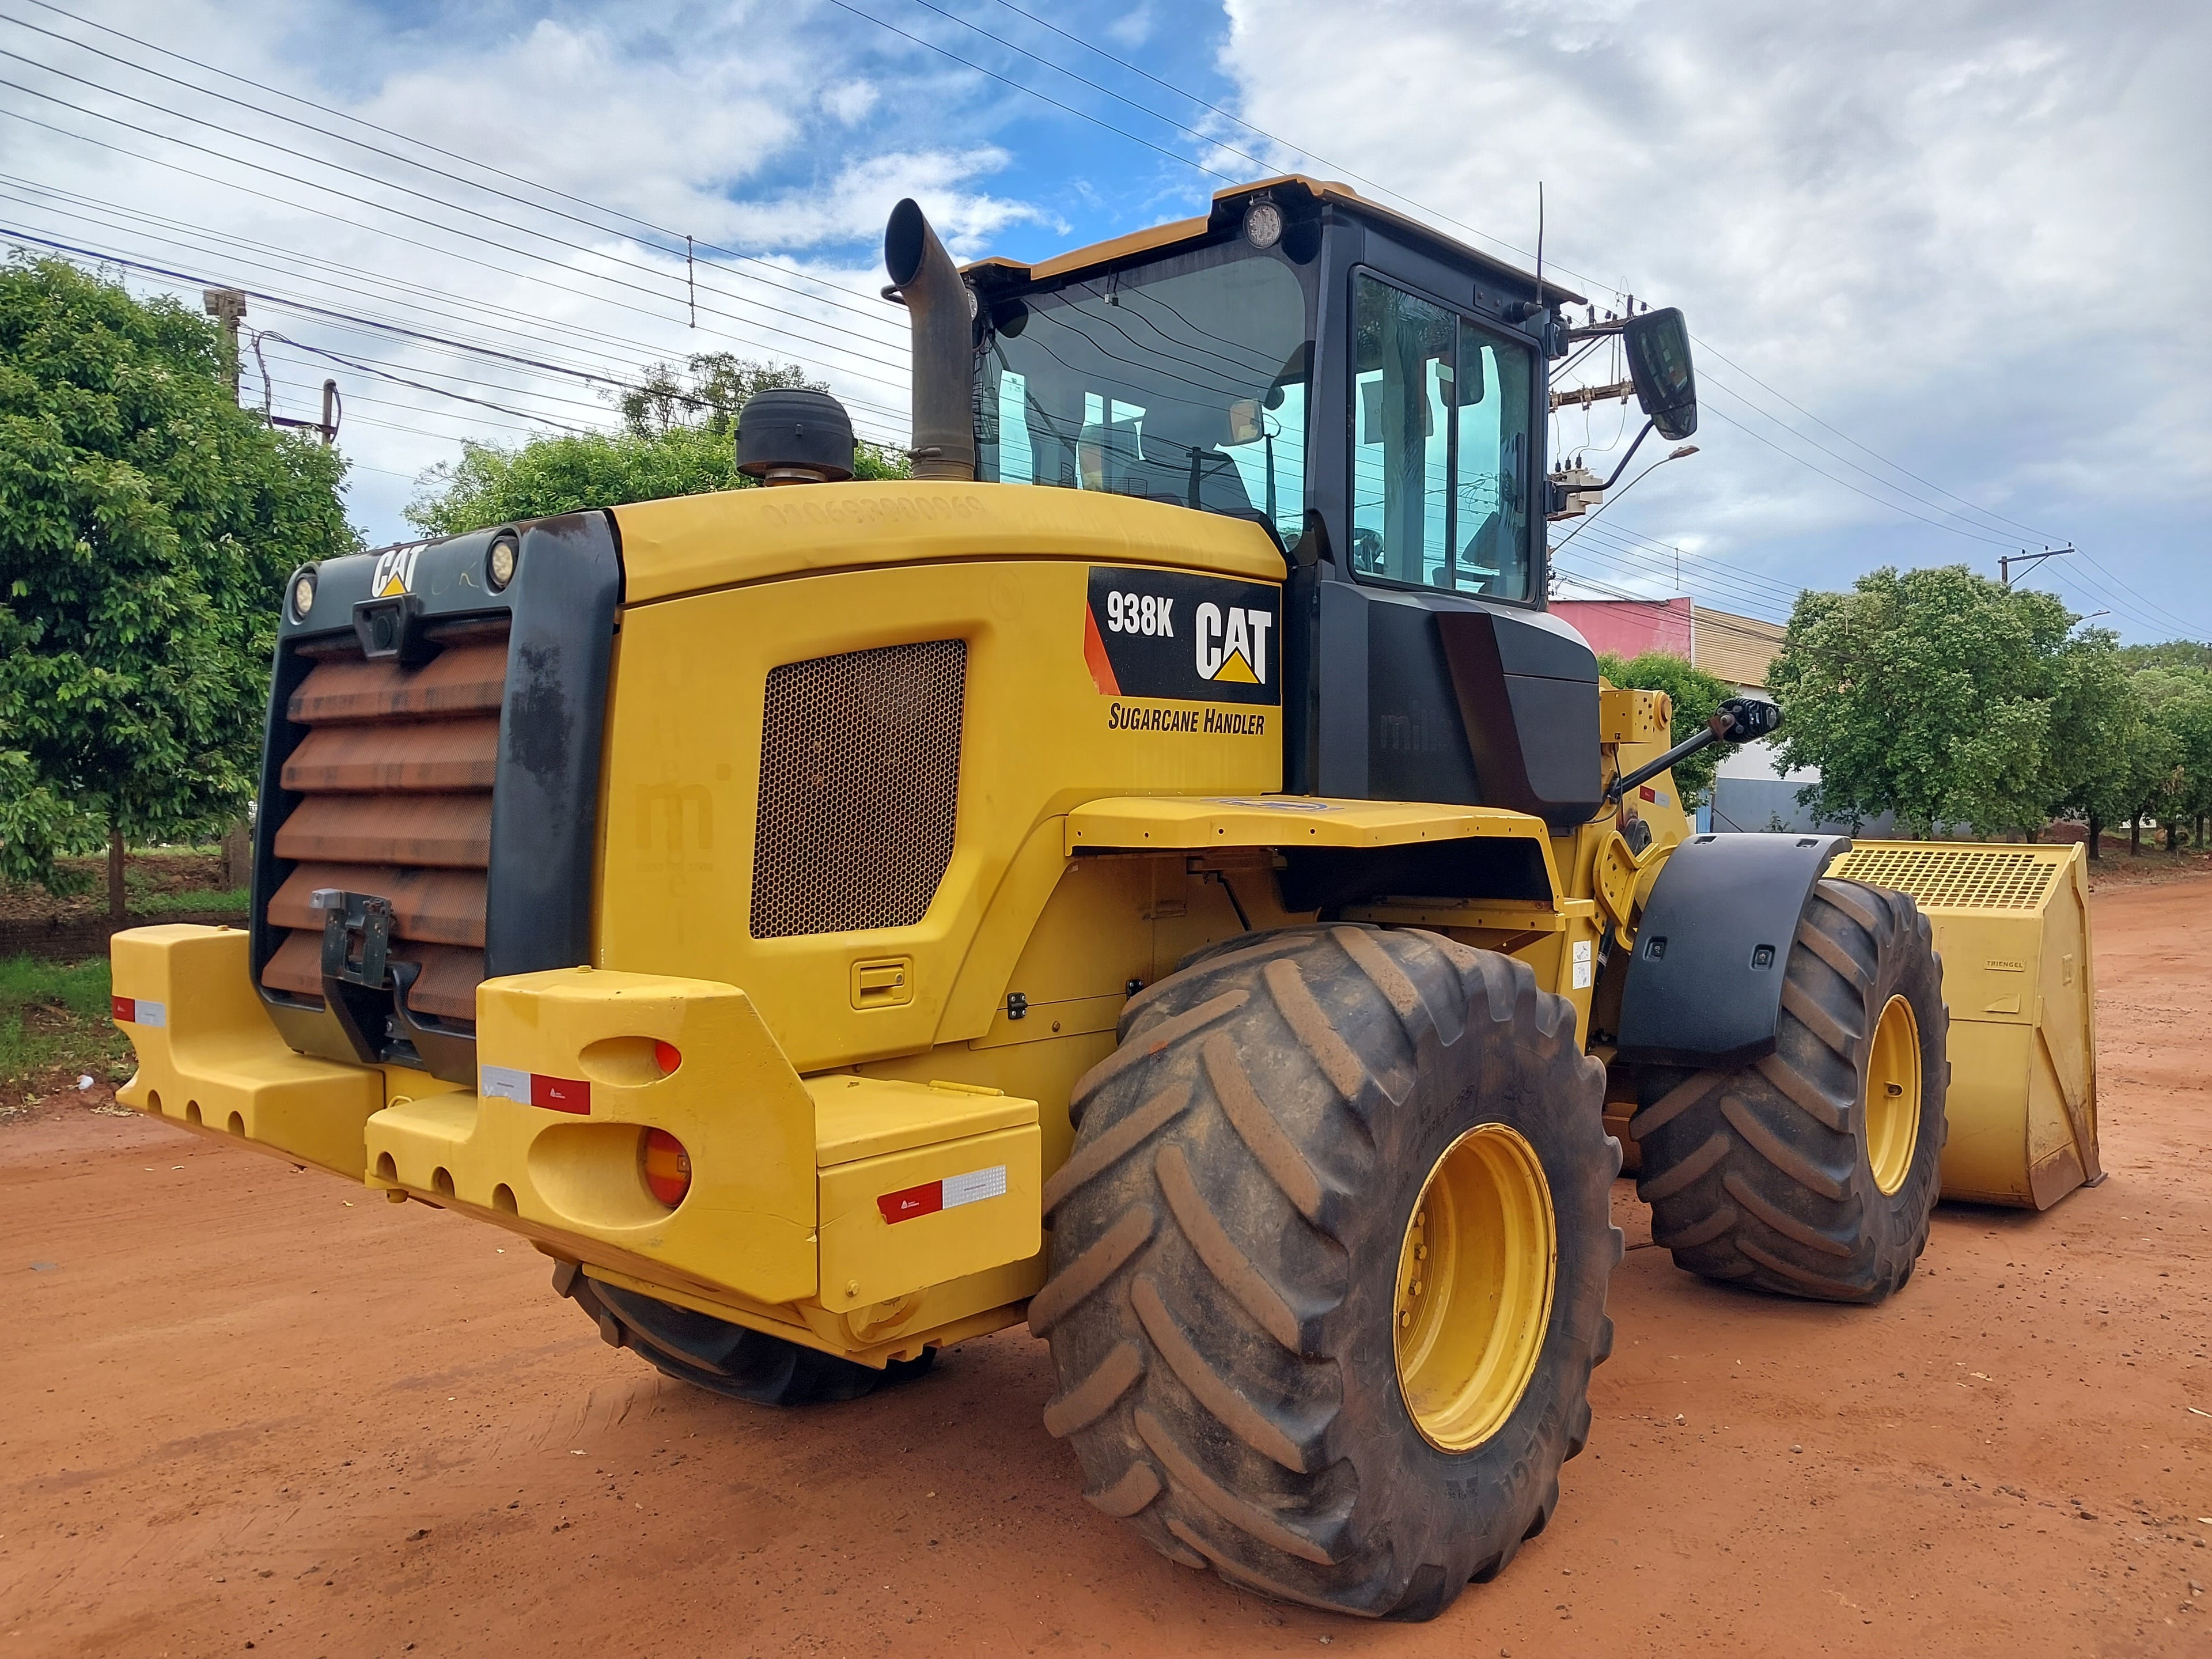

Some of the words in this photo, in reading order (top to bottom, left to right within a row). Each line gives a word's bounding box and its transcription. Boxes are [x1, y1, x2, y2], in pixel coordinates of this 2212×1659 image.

[371, 543, 429, 598] CAT
[1107, 590, 1175, 638] 938K
[1195, 602, 1272, 684] CAT
[1987, 960, 2023, 968] TRIENGEL
